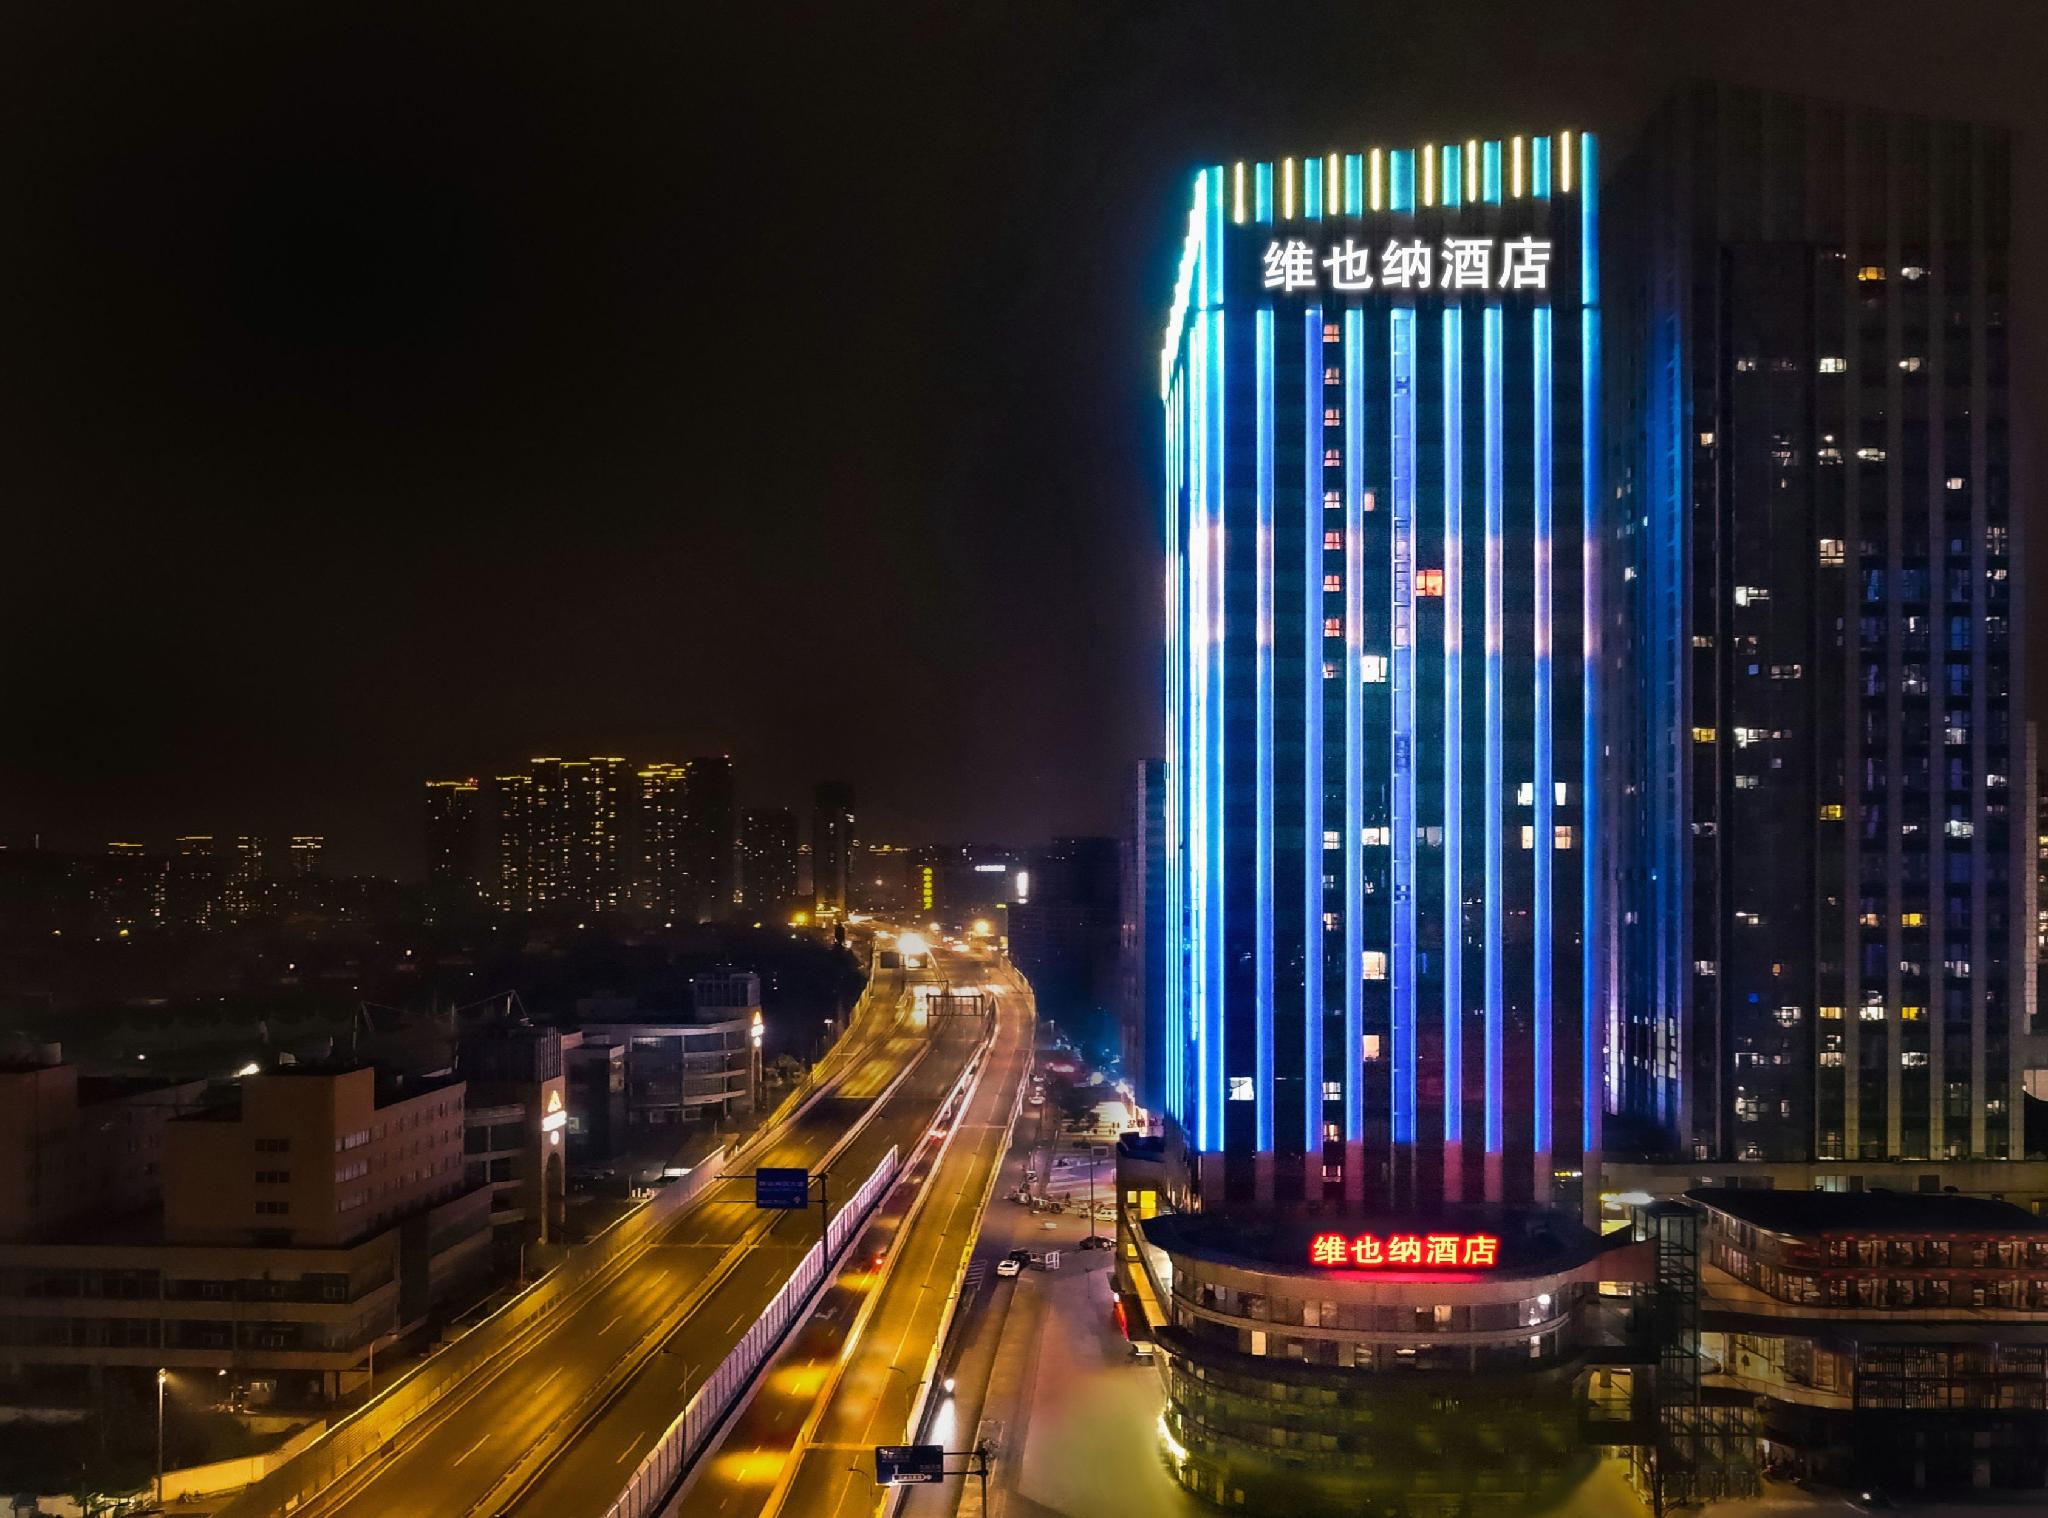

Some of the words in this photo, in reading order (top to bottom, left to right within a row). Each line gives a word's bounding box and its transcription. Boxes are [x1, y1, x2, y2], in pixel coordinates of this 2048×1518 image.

[1263, 236, 1552, 292] 维也纳酒店
[1312, 1234, 1498, 1265] 维也纳酒店
